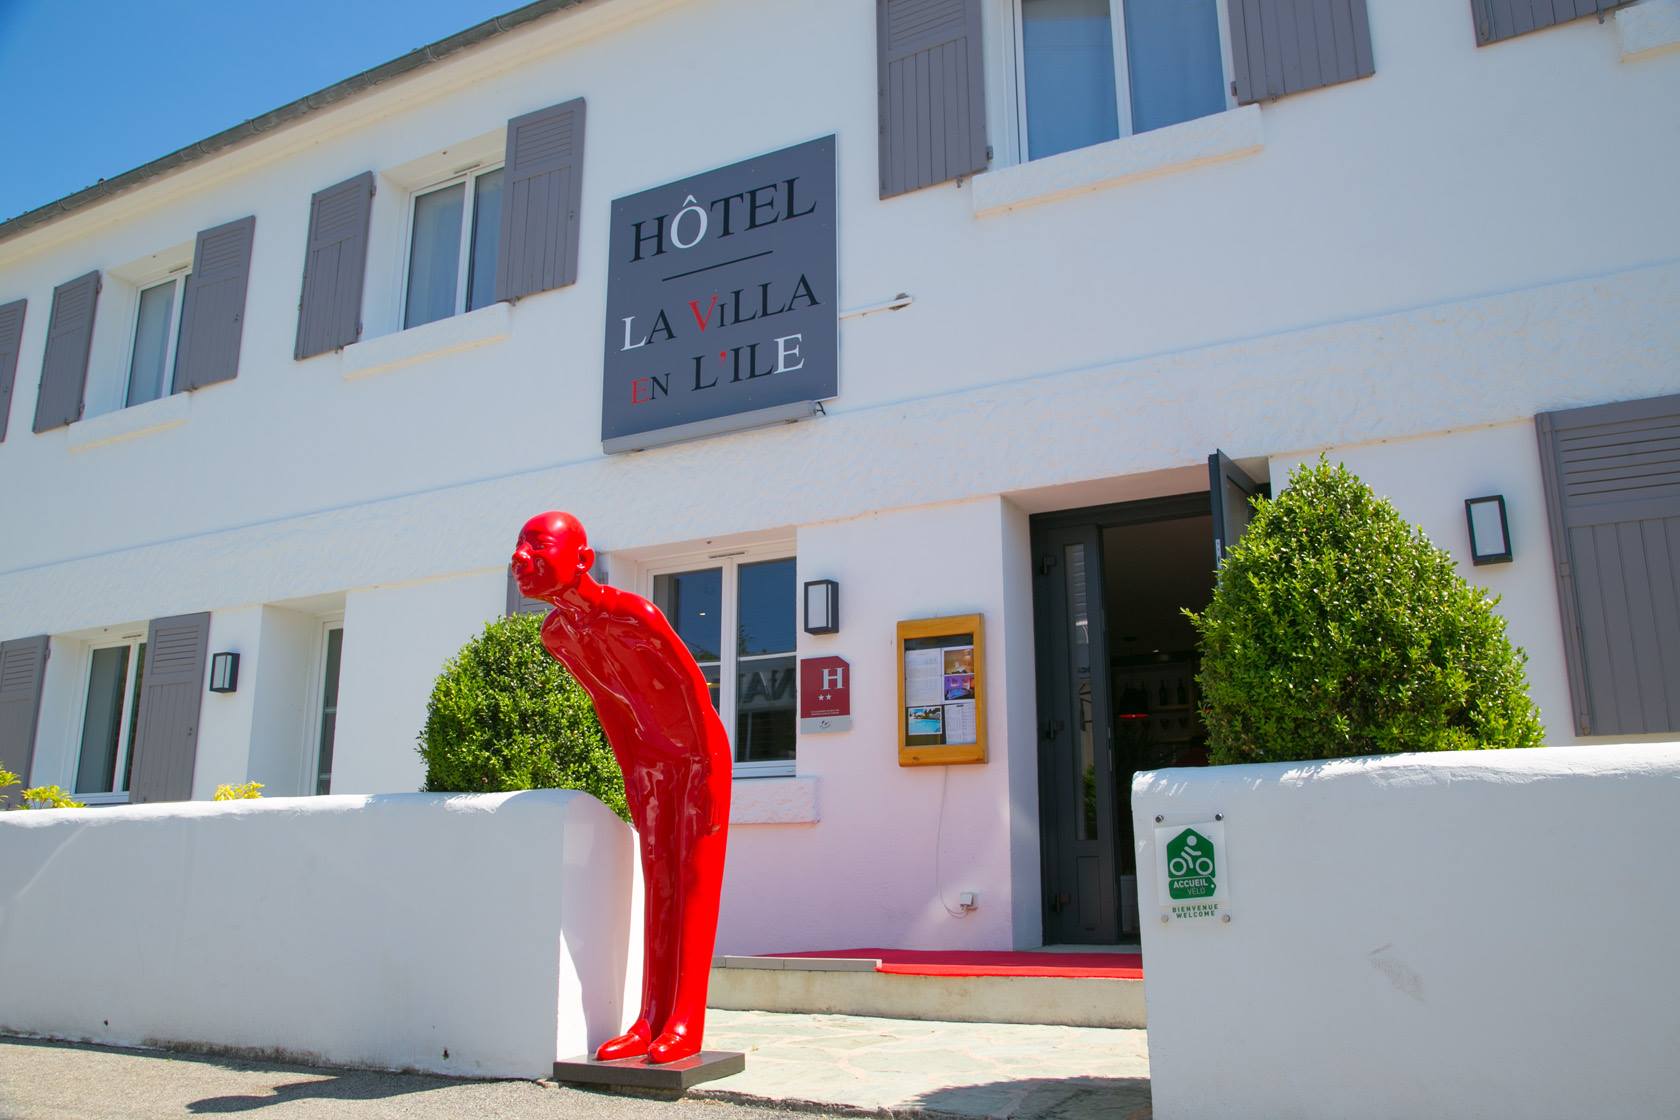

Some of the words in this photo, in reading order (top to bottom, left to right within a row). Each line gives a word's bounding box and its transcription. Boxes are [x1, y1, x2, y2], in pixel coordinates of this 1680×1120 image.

[630, 177, 817, 263] HÔTEL
[620, 309, 677, 351] LA
[688, 273, 821, 333] VILLA
[631, 373, 671, 405] EN
[691, 333, 805, 392] L'ILE
[822, 667, 845, 690] H
[1173, 878, 1208, 889] ACCUEIL
[1172, 903, 1219, 913] BIENVENUE
[1176, 910, 1216, 919] WELCOME
